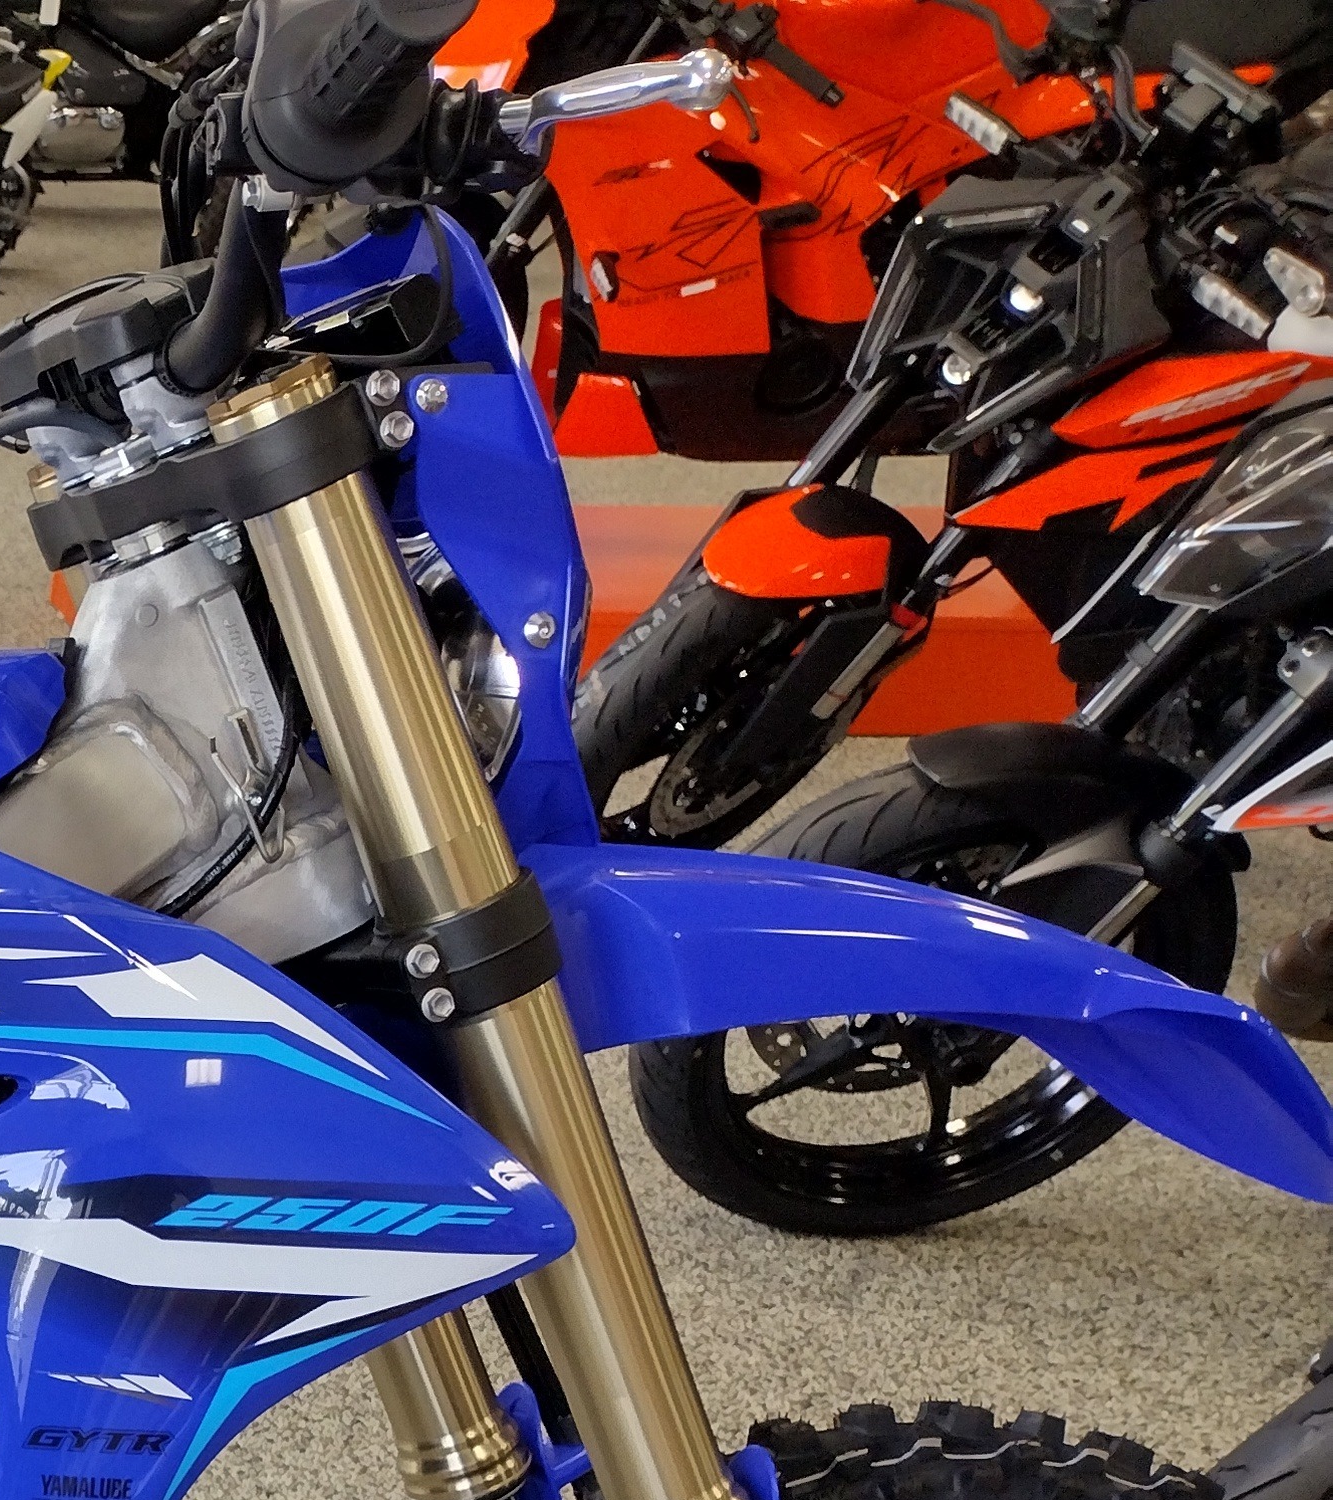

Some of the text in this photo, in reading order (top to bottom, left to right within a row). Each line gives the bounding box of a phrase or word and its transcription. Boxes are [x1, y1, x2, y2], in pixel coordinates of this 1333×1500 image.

[153, 1193, 514, 1236] 250F
[24, 1425, 175, 1455] GYTR
[41, 1474, 133, 1500] YAMALUBE
